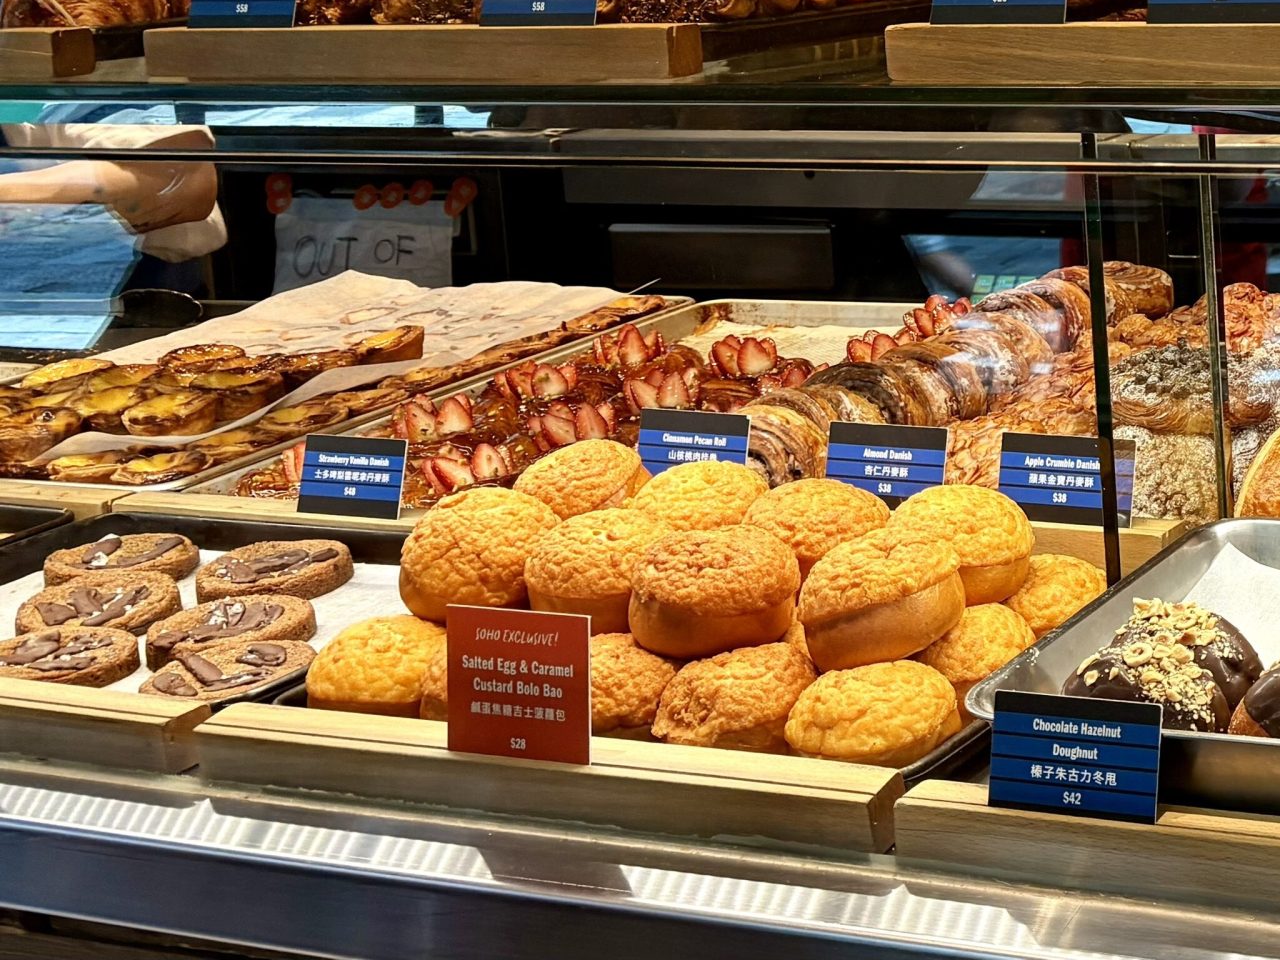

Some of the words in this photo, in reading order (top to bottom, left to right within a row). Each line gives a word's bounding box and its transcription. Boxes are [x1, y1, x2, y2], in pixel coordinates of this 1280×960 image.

[532, 2, 545, 11] $58
[293, 236, 358, 278] OUT
[374, 235, 415, 265] OF
[663, 433, 693, 444] Cinnamon
[694, 435, 712, 445] Pecan
[714, 437, 727, 446] Roll
[863, 448, 888, 459] Almond
[890, 450, 912, 460] Danish
[370, 457, 389, 466] Danish
[1025, 456, 1044, 468] Apple
[1046, 457, 1074, 468] Crumble
[1076, 460, 1100, 470] Danish
[878, 483, 892, 493] $38
[1053, 493, 1067, 503] $38
[462, 655, 493, 670] Salted
[498, 658, 516, 675] Egg
[519, 660, 528, 673] &
[531, 661, 573, 678] Caramel
[473, 677, 513, 693] Custard
[517, 681, 539, 696] Bolo
[543, 684, 562, 698] Bao
[1033, 718, 1078, 734] Chocolate
[1081, 723, 1121, 738] Hazelnut
[510, 738, 526, 750] $28
[1053, 744, 1098, 760] Doughnut
[1063, 791, 1082, 805] $42
